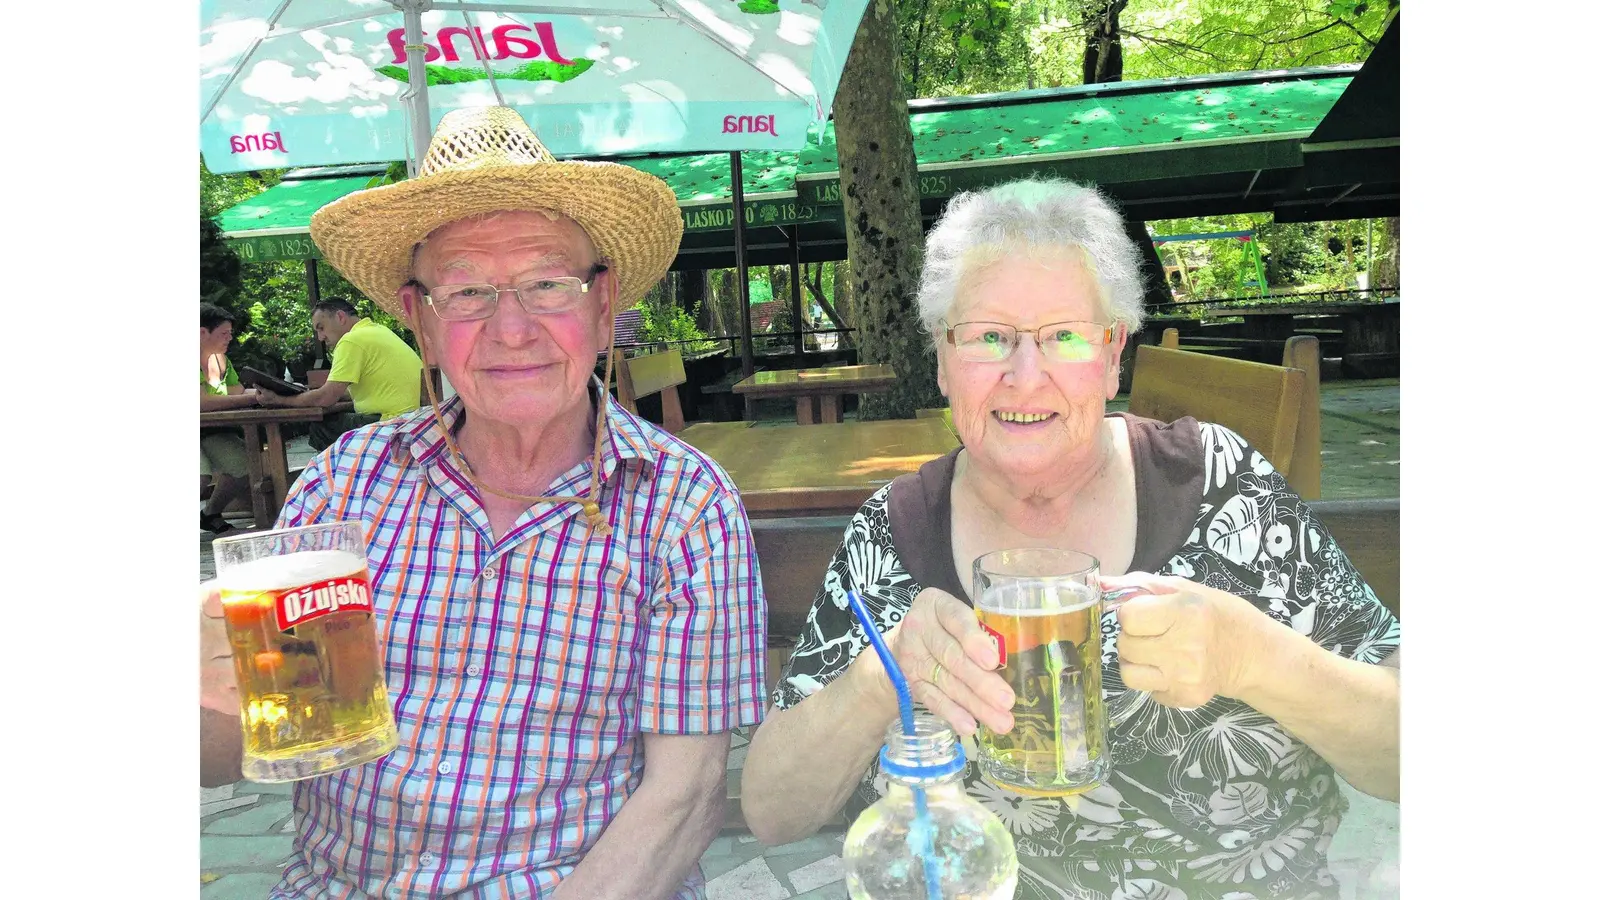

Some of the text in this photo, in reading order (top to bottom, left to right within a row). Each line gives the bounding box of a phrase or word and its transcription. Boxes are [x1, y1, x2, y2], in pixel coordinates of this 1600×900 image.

[815, 175, 952, 202] LAŠ 825!
[686, 206, 725, 229] LAŠKO
[726, 206, 755, 226] PO
[283, 579, 369, 623] Ožujsko
